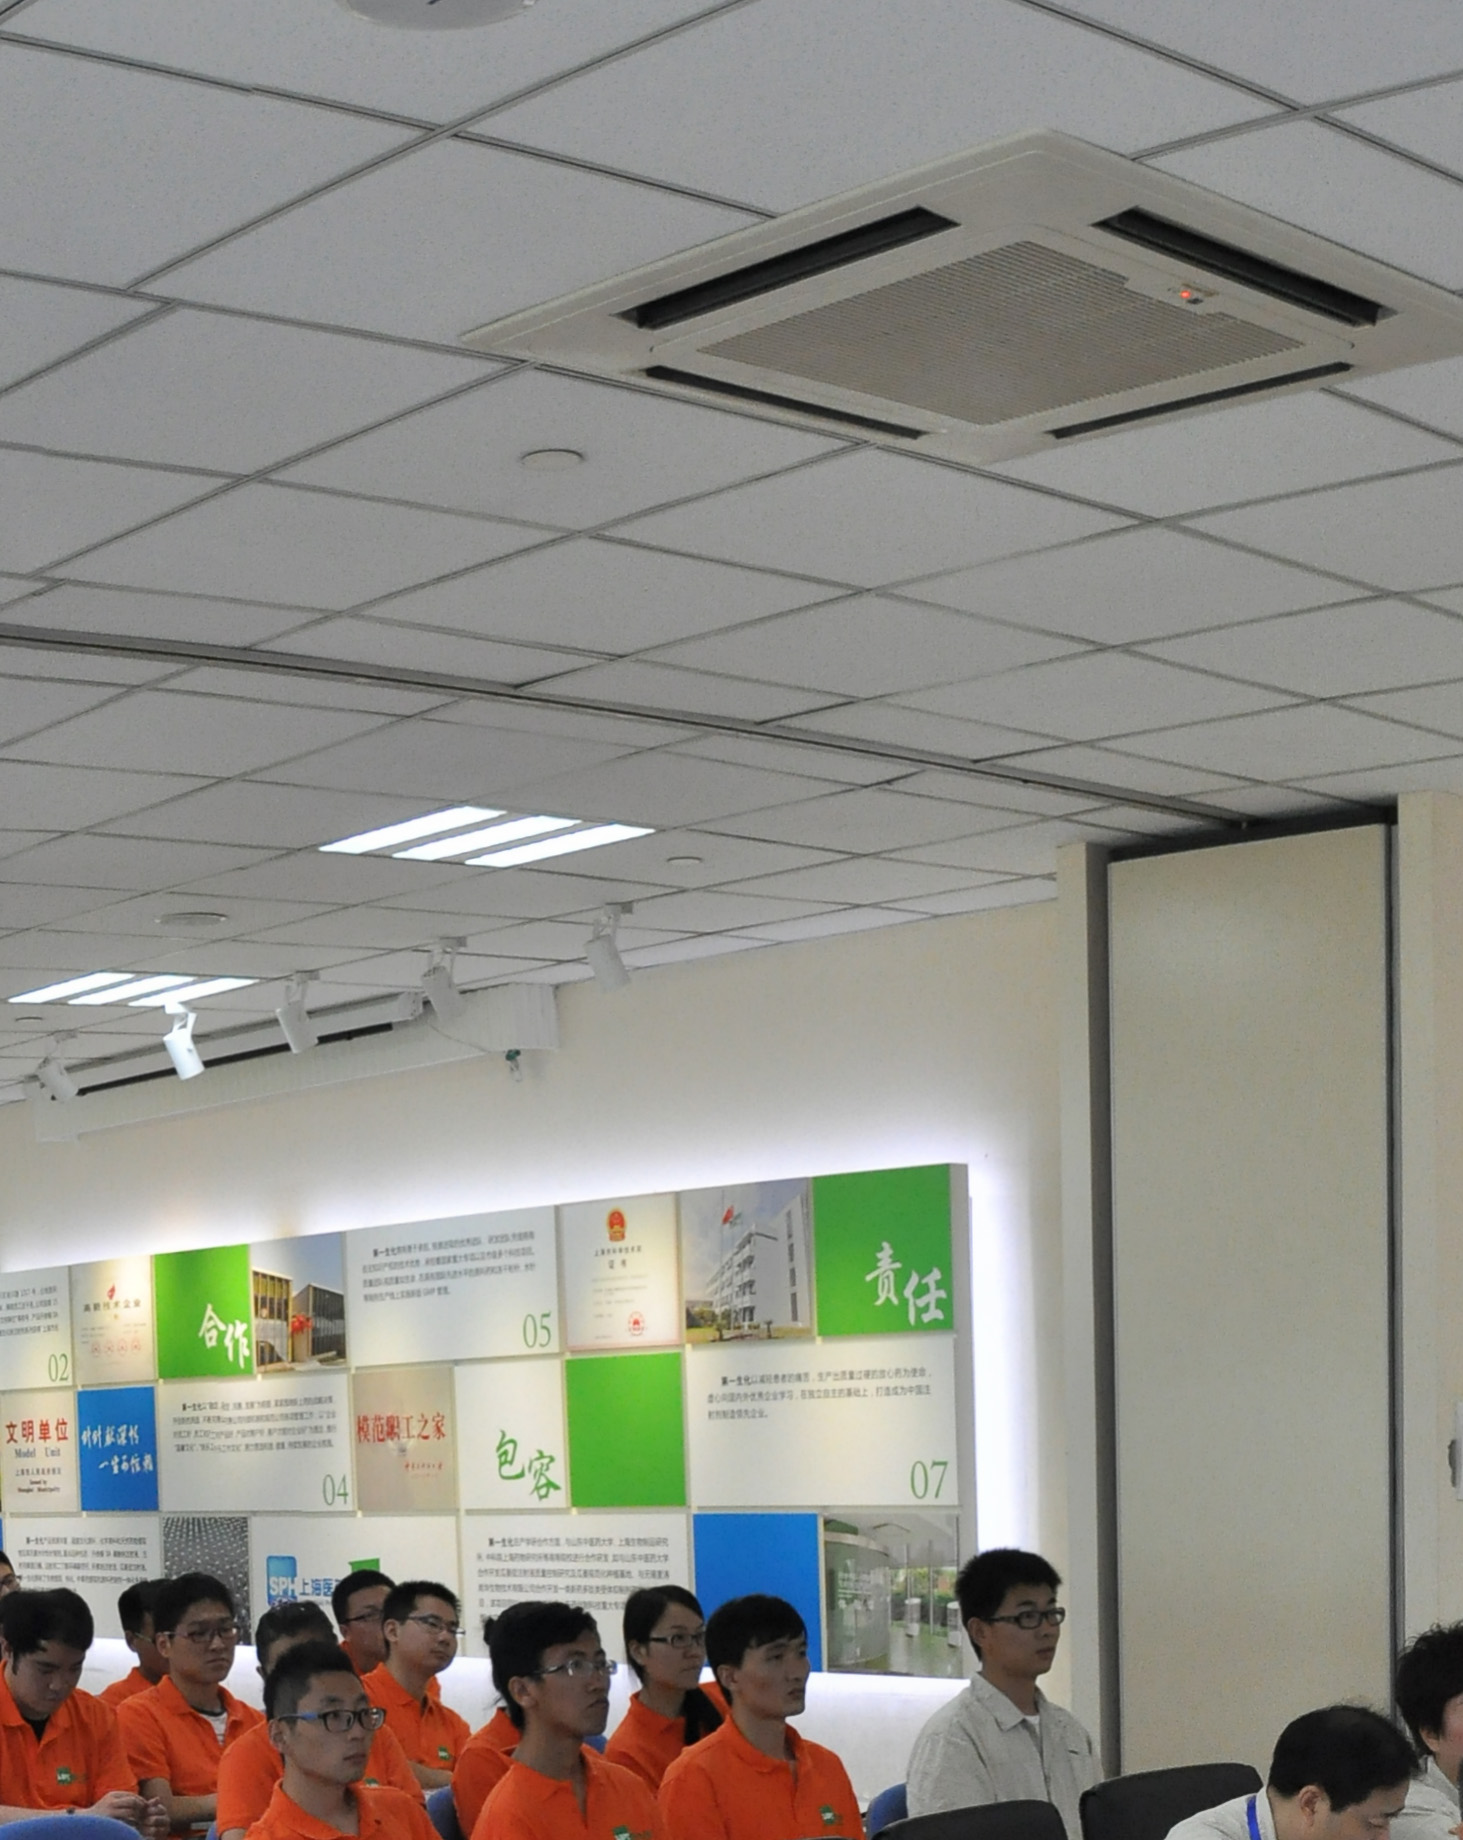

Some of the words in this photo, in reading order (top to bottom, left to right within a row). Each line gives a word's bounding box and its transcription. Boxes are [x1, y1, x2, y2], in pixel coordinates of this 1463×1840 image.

[865, 1241, 948, 1327] 责任
[198, 1303, 250, 1369] 合作
[522, 1311, 552, 1348] 05
[47, 1353, 70, 1382] 02
[5, 1417, 69, 1445] 文明单位
[14, 1447, 36, 1460] Model
[44, 1446, 62, 1459] Unit
[496, 1429, 562, 1501] 包容
[322, 1473, 349, 1506] 04
[910, 1459, 949, 1500] 07
[269, 1576, 297, 1596] SPH
